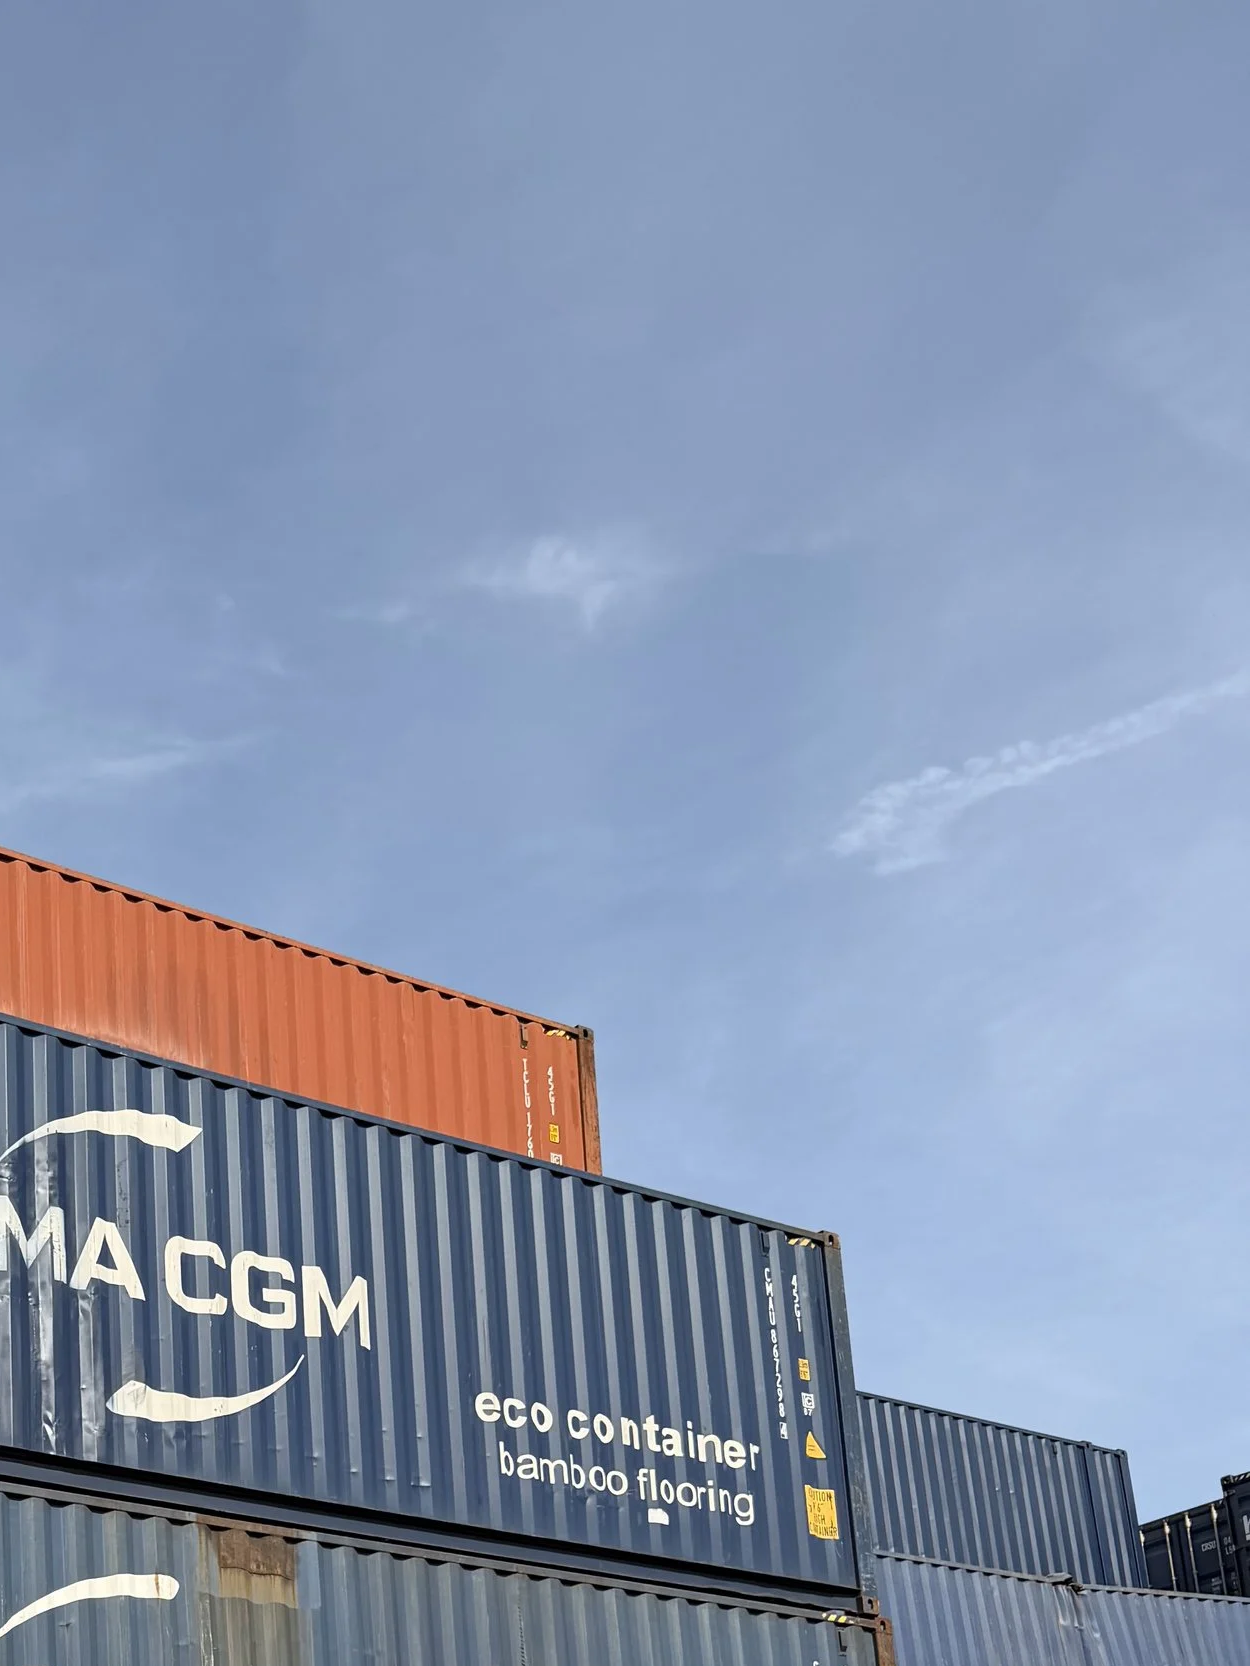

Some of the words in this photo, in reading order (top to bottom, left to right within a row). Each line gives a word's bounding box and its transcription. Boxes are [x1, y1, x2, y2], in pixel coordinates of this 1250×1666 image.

[522, 1057, 531, 1109] TCLU
[547, 1066, 556, 1116] 45G1
[164, 1234, 371, 1351] CGM
[791, 1274, 802, 1332] 45G1
[764, 1267, 776, 1326] CMAU
[770, 1328, 786, 1418] 867298
[475, 1391, 552, 1436] eco
[566, 1408, 759, 1471] container
[499, 1441, 628, 1496] bamboo
[637, 1468, 755, 1526] flooring
